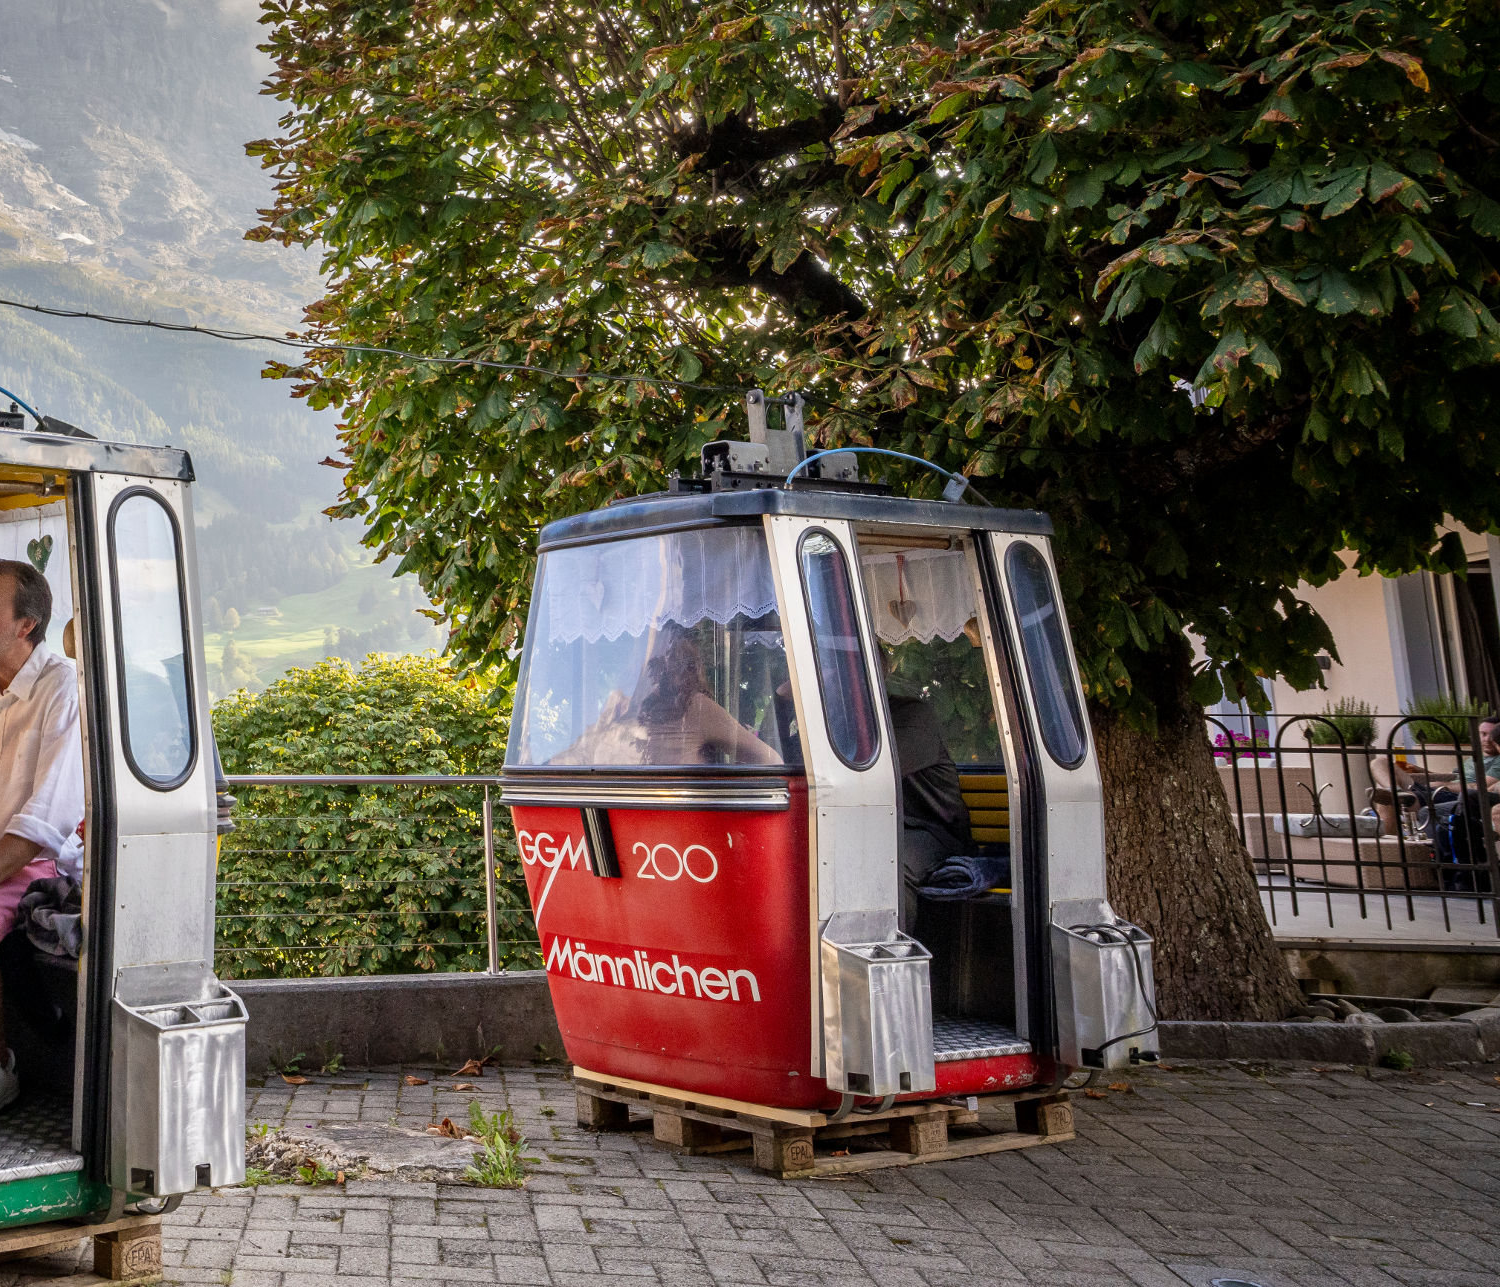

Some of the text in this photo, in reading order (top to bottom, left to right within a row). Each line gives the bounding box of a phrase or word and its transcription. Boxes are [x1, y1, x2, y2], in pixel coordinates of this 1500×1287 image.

[632, 842, 719, 883] 200
[546, 935, 761, 1002] Männlichen
[791, 1145, 812, 1161] EPAL
